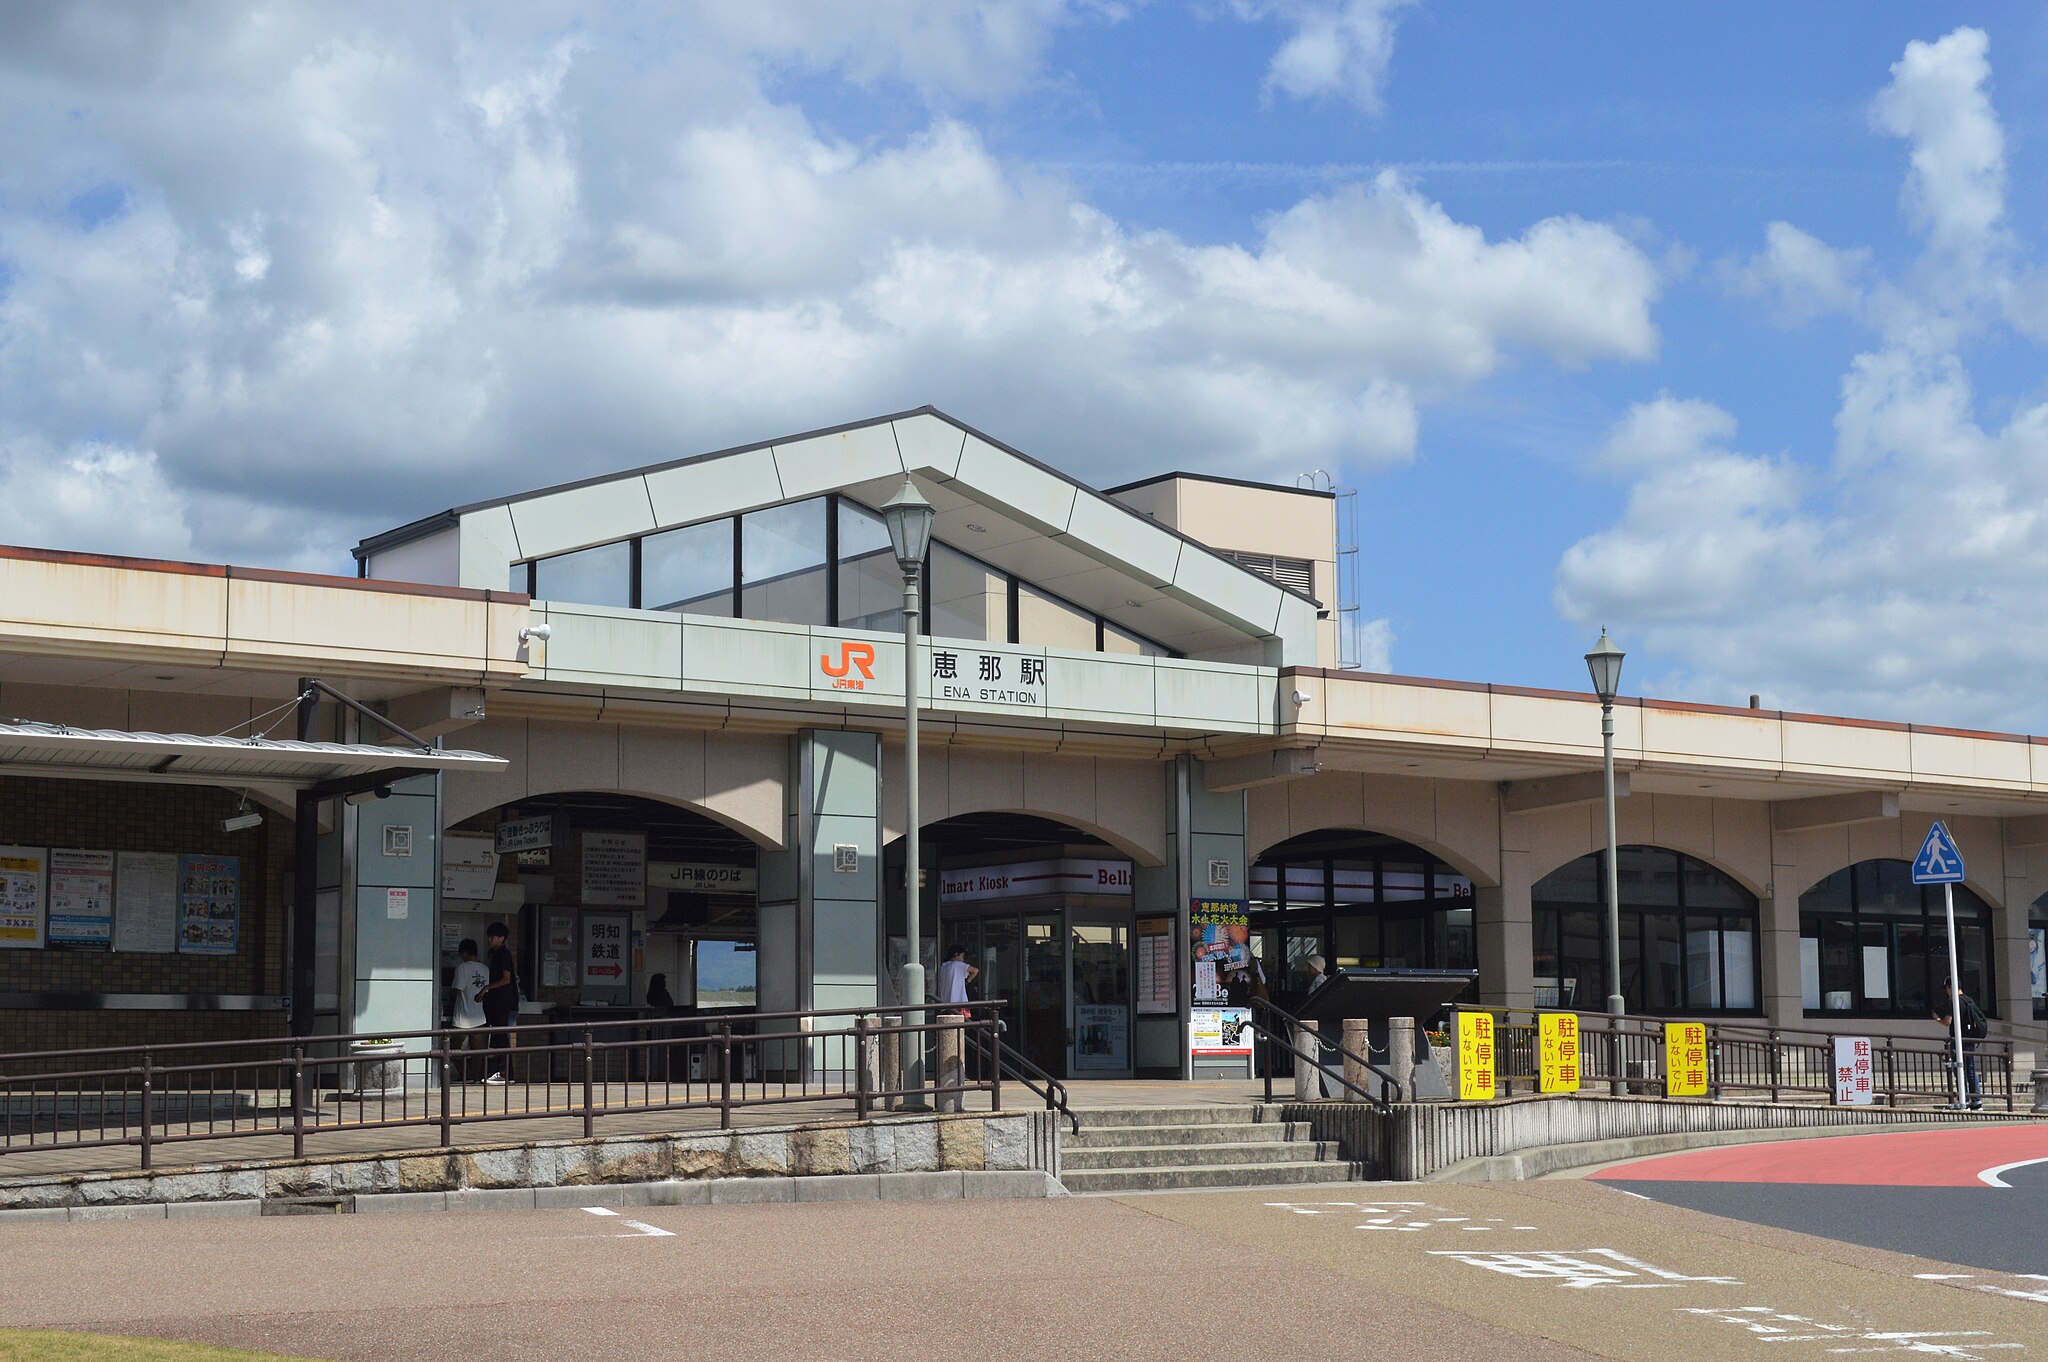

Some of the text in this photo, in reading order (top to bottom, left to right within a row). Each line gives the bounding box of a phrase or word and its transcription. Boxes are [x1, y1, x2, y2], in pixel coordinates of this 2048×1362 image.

[821, 641, 876, 680] JR
[932, 650, 1045, 686] 恵那駅
[832, 679, 864, 690] JR東海
[943, 685, 1037, 704] ENA STATION
[529, 856, 546, 865] Tickets
[670, 867, 742, 882] JR線のりば
[978, 875, 1009, 892] Kiosk
[592, 923, 620, 938] 明知
[591, 943, 621, 959] 鉄道
[1475, 1017, 1492, 1091] 駐停車
[1557, 1017, 1577, 1085] 駐停車
[1684, 1027, 1704, 1089] 駐停車
[1853, 1040, 1870, 1093] 駐停車
[1837, 1066, 1854, 1103] 禁止
